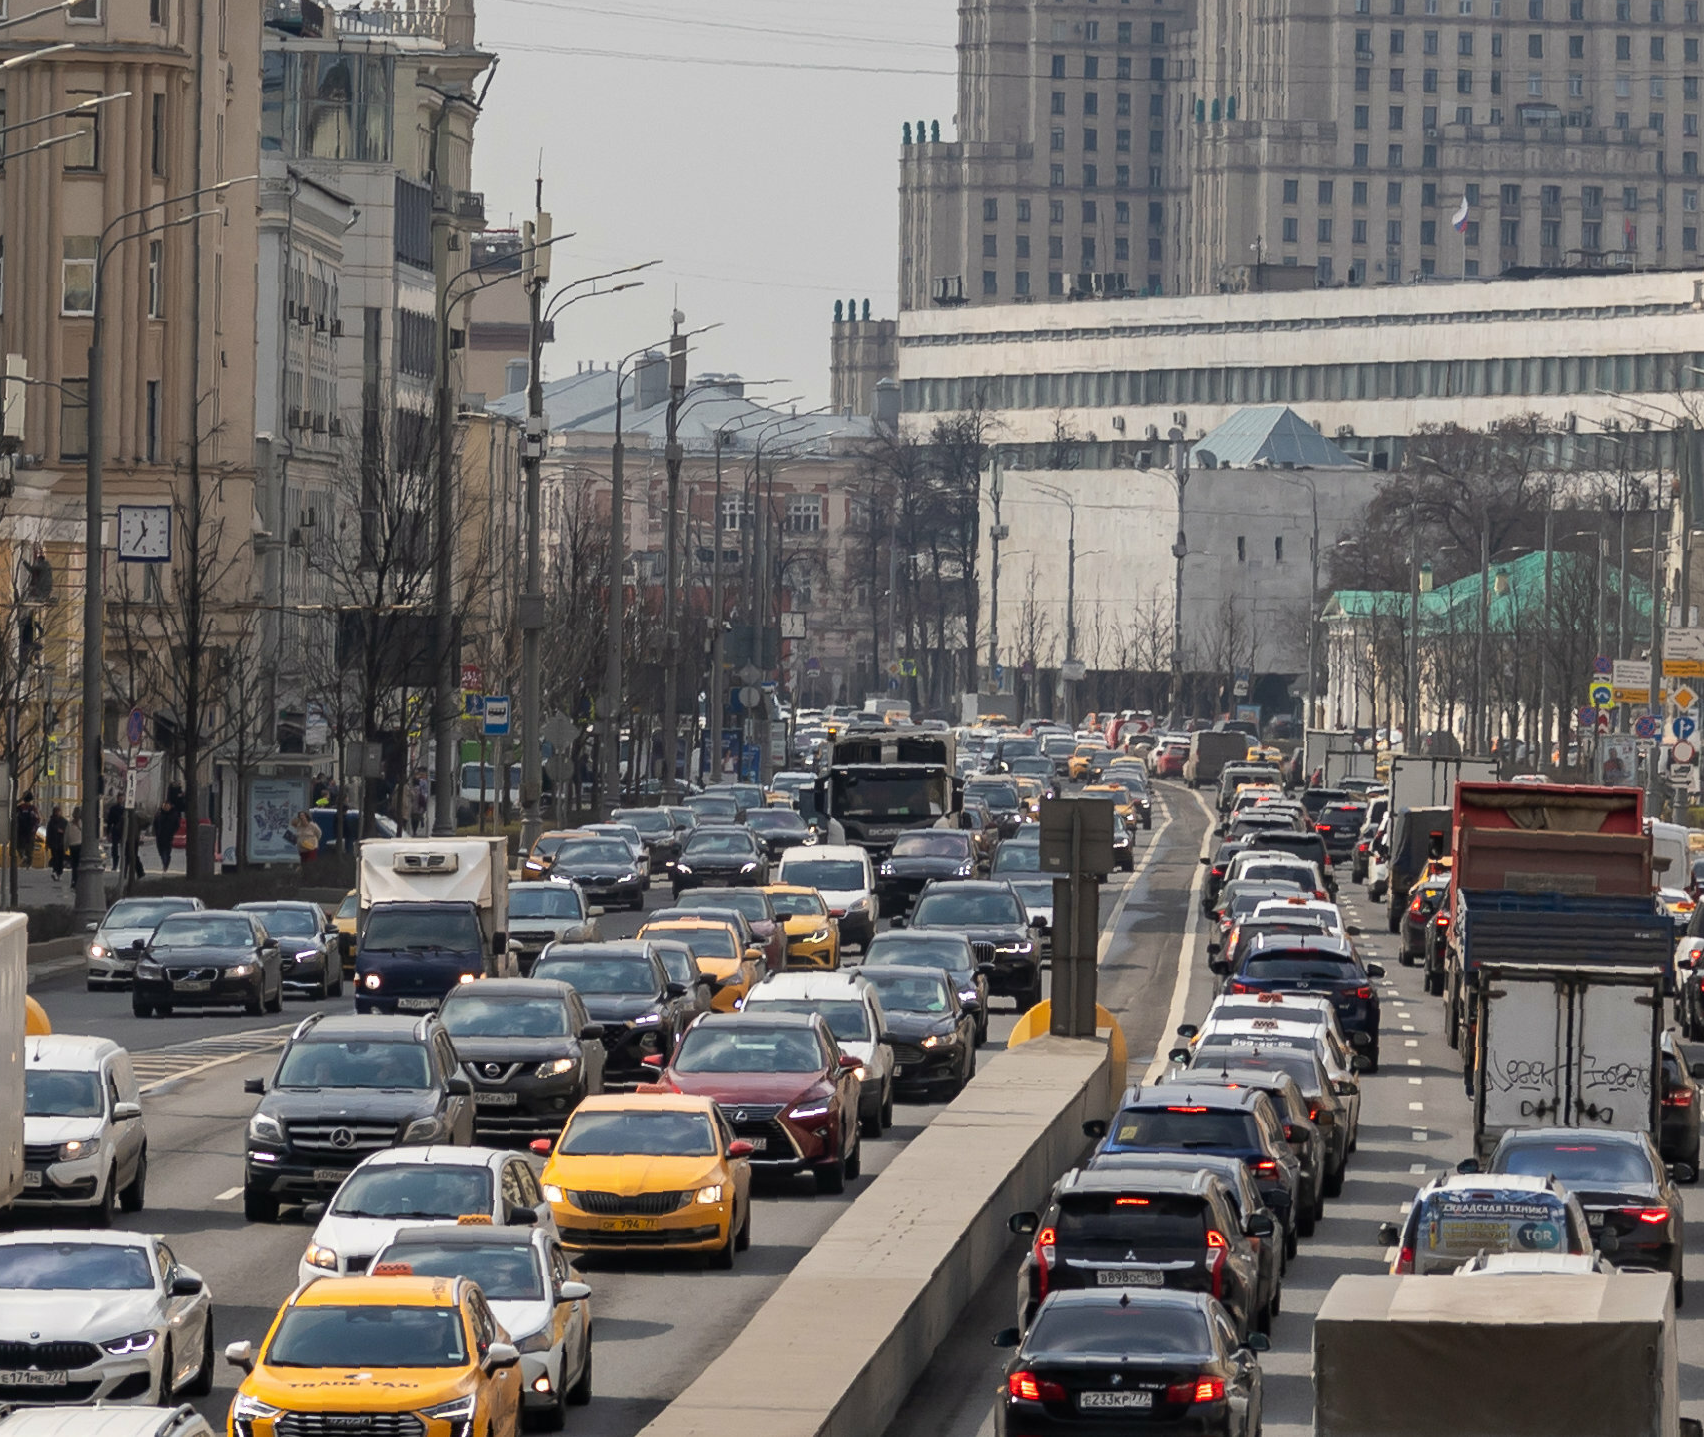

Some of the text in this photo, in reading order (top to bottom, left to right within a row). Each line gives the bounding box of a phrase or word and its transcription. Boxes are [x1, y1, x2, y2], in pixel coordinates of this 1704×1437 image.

[1504, 1204, 1549, 1215] ТЕХНИКА
[1523, 1229, 1553, 1242] TOR
[288, 1380, 420, 1389] TRADE TAXI
